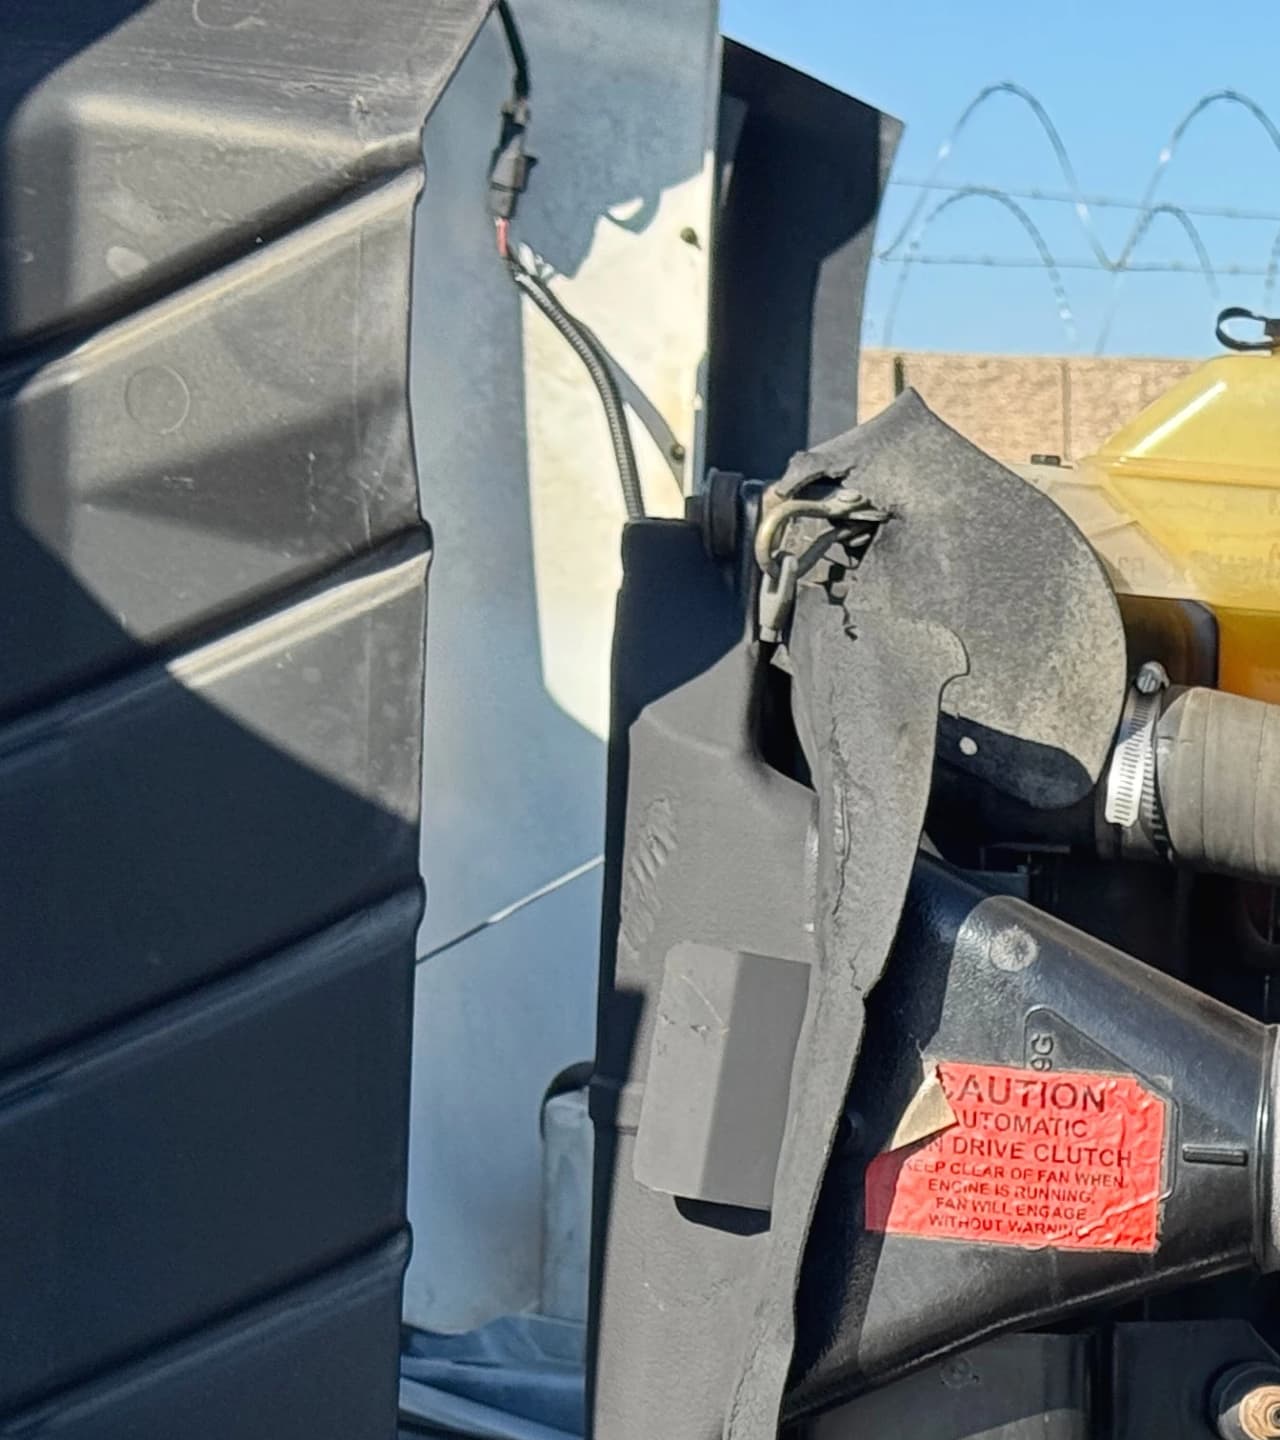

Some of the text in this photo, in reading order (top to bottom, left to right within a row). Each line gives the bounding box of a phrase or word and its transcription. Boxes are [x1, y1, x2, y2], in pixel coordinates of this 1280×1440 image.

[955, 1109, 1088, 1138] UTOMATIC
[953, 1136, 1027, 1160] DRIVE
[1034, 1143, 1131, 1168] CLUTCH
[950, 1162, 1004, 1178] CLEAR
[1011, 1167, 1033, 1180] OF
[1037, 1169, 1070, 1183] FAN
[928, 1178, 990, 1195] ENGINE
[995, 1184, 1010, 1198] IS
[936, 1197, 1088, 1220] FAN WILL ENGAGE
[929, 1213, 1003, 1232] WITHOUT
